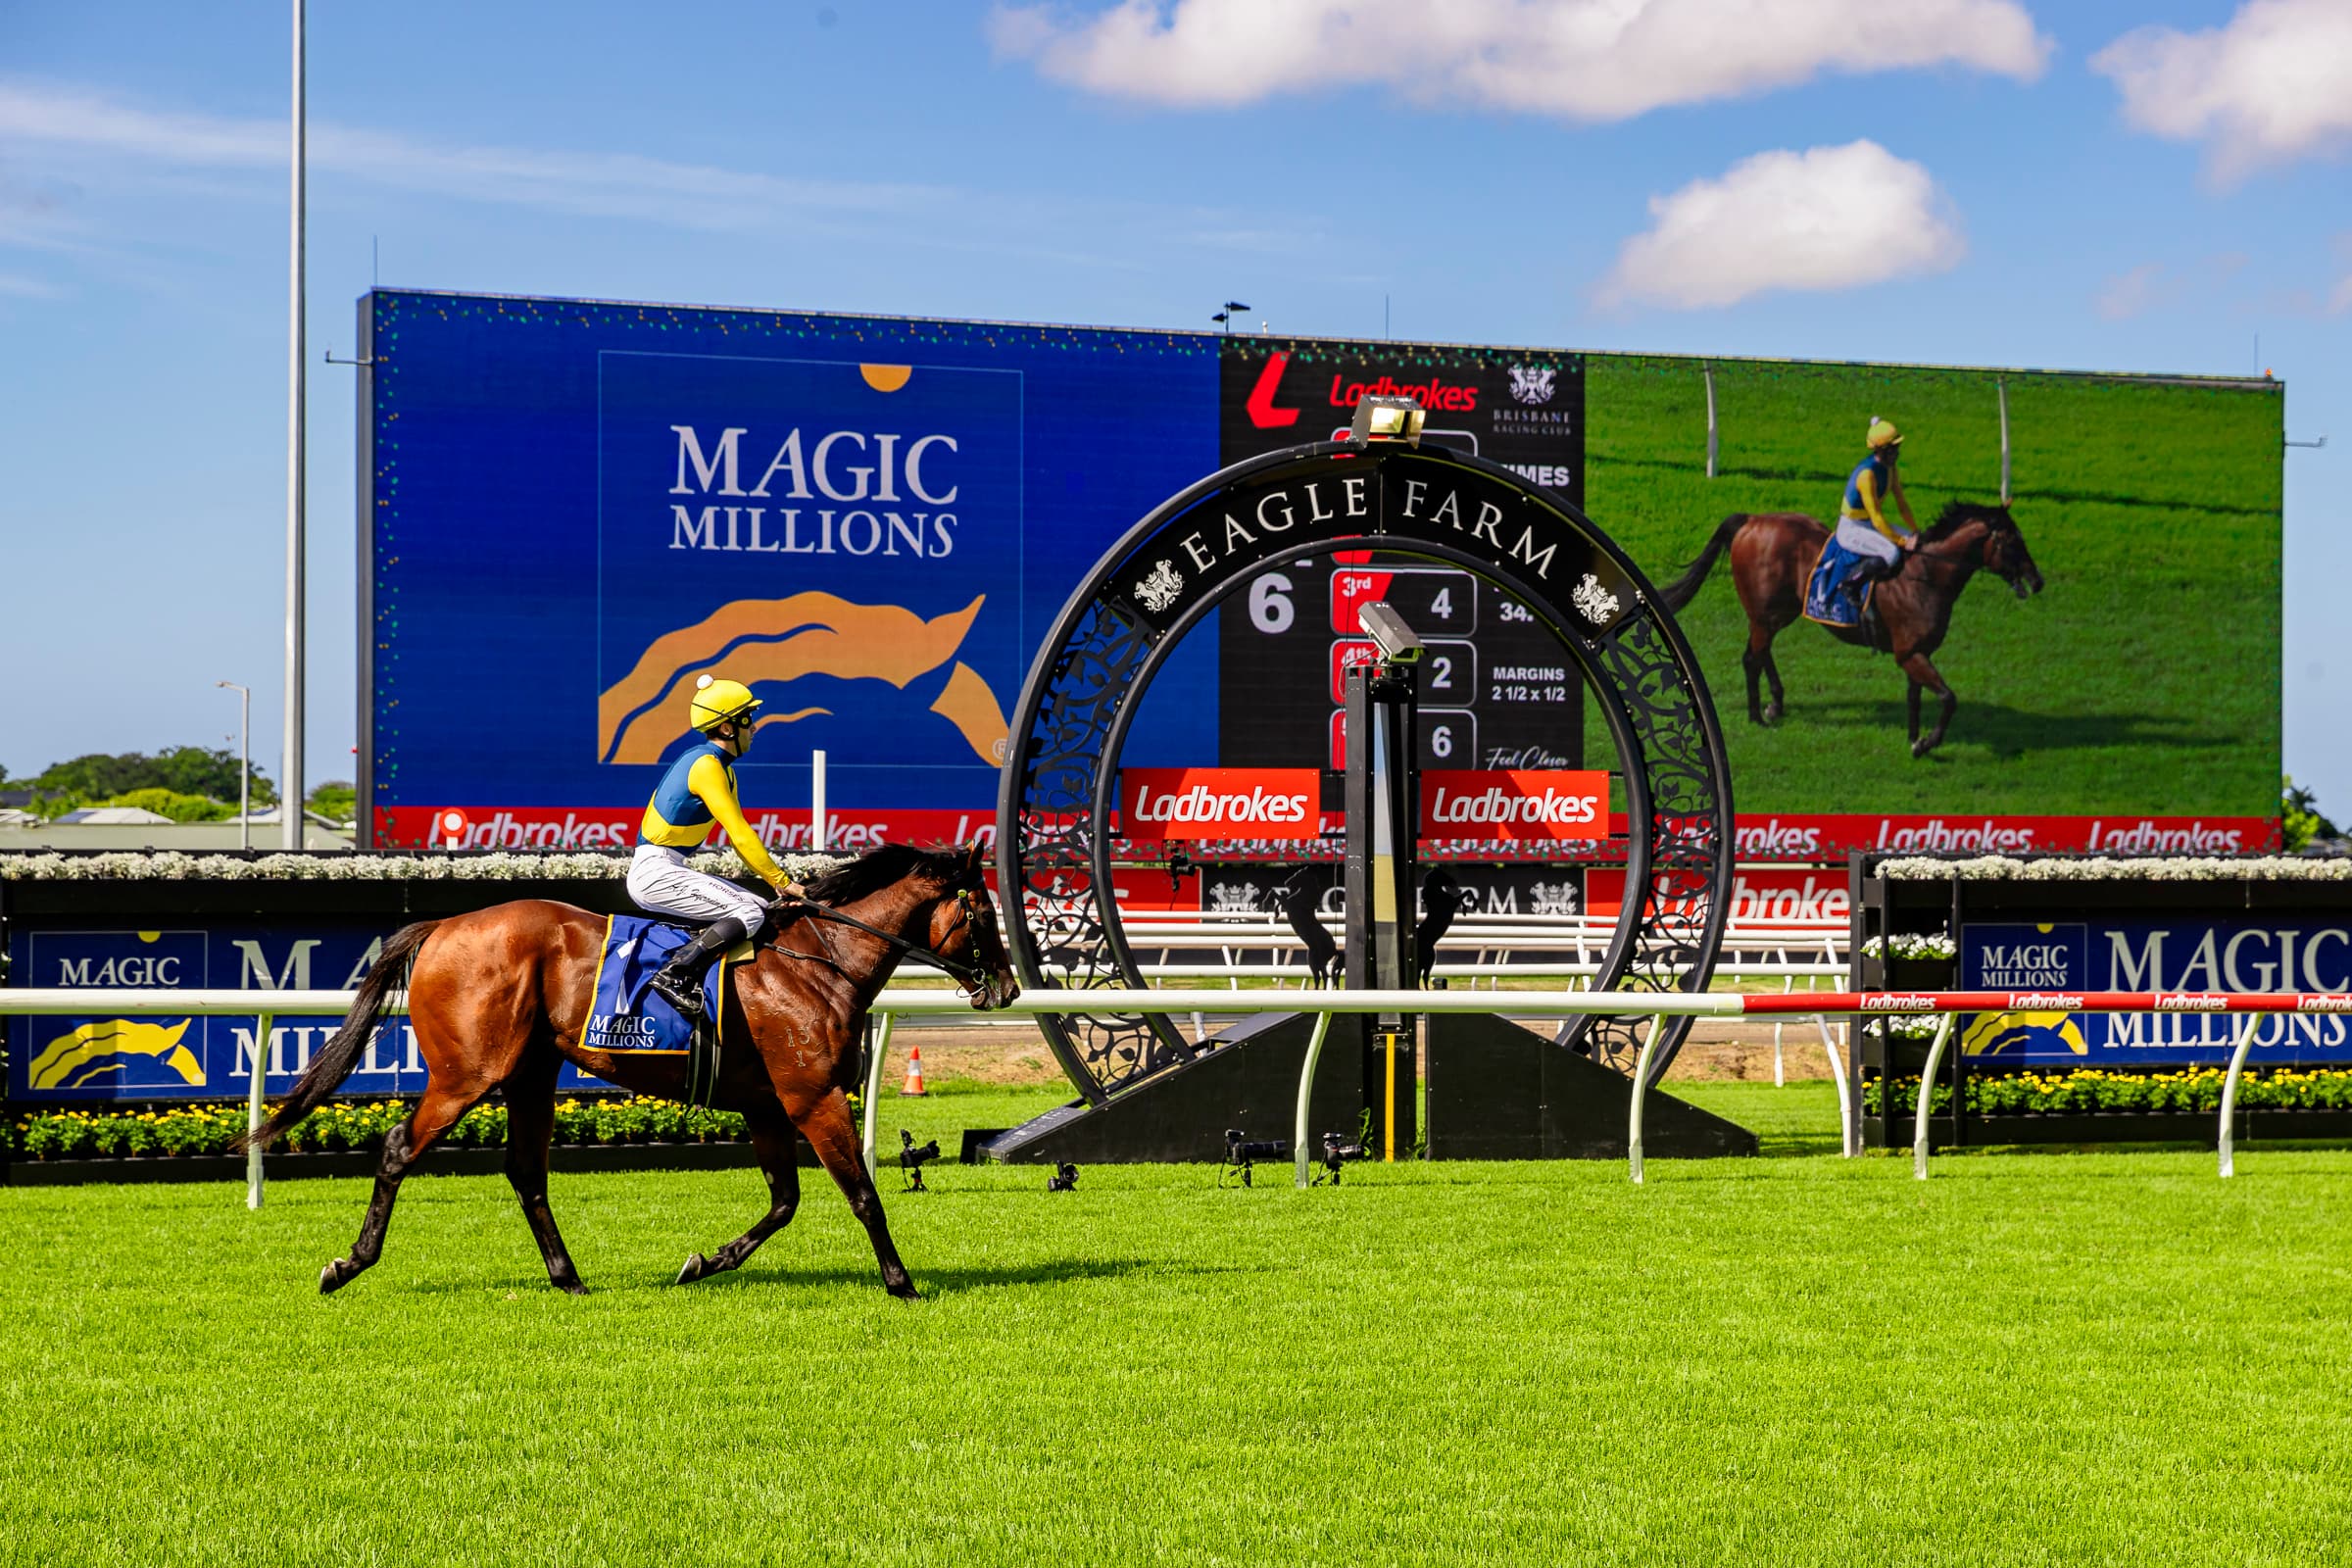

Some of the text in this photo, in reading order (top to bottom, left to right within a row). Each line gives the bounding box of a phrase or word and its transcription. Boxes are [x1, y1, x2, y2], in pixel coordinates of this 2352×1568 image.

[669, 424, 958, 506] MAGIC
[1501, 464, 1570, 487] IMES
[668, 504, 958, 559] MILLIONS
[1179, 477, 1558, 580] EAGLE FARM
[1342, 574, 1372, 597] 3rd
[1249, 571, 1295, 634] 6
[1431, 587, 1453, 619] 4
[1431, 657, 1452, 689] 2
[1492, 666, 1566, 681] MARGINS
[1492, 686, 1567, 702] 2 1/2 x 1/2
[1431, 725, 1453, 759] 6
[1486, 745, 1569, 771] Feel Closer
[1135, 785, 1308, 822] Ladbrokes
[1432, 787, 1598, 823] Ladbrokes
[703, 813, 888, 850] dbrokes
[1876, 819, 2035, 853] Ladbrokes
[2088, 820, 2242, 854] Ladbrokes
[58, 956, 181, 987] MAGIC
[1981, 945, 2069, 970] MAGIC
[2104, 927, 2350, 994] MAGIC
[1981, 970, 2068, 988] MILLIONS
[1859, 993, 1937, 1011] Ladbrokes
[2008, 993, 2084, 1010] Ladbrokes
[2154, 994, 2230, 1011] Ladbrokes
[589, 1014, 656, 1035] MAGIC
[588, 1032, 656, 1049] MILLIONS
